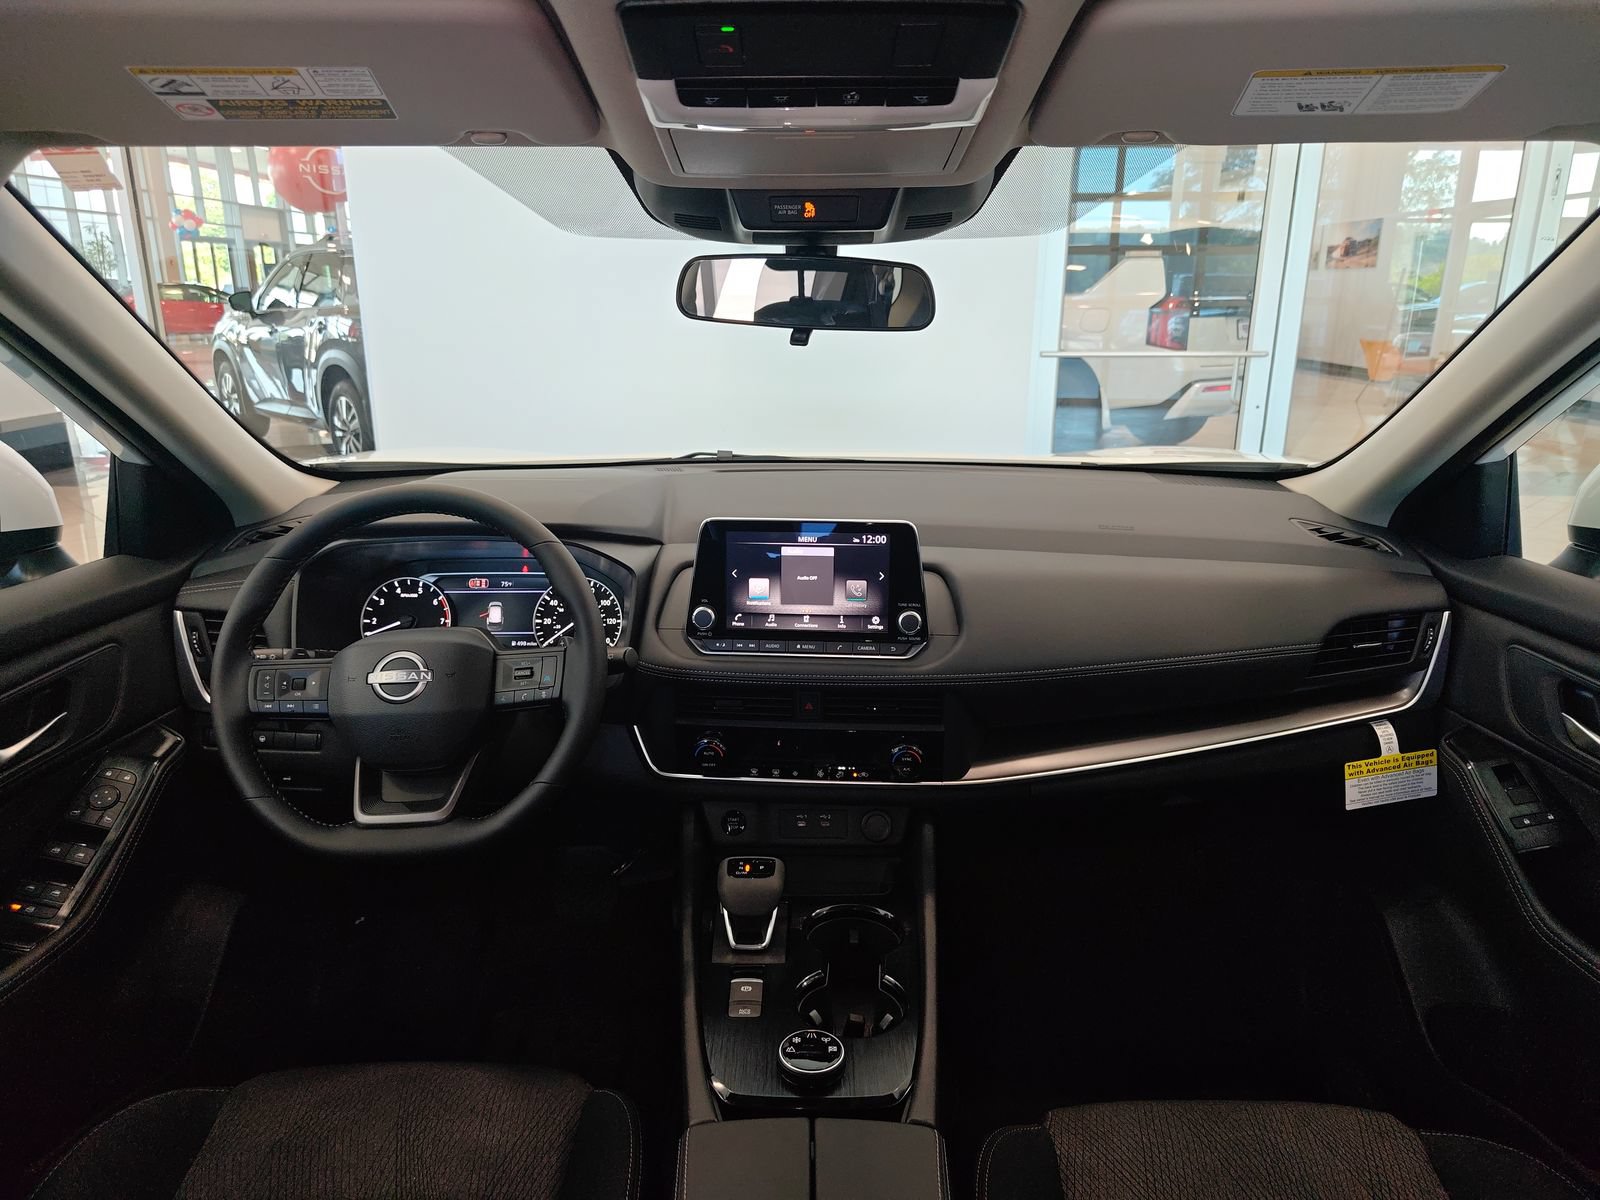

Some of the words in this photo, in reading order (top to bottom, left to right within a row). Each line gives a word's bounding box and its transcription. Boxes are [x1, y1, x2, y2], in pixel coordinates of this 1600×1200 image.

[218, 99, 288, 107] AIRBAG
[296, 99, 384, 107] WARNING
[862, 535, 887, 544] 12:00
[379, 598, 385, 606] 3
[432, 598, 438, 606] 6
[371, 617, 377, 625] 2
[369, 671, 432, 682] NISSAN
[1364, 759, 1391, 767] Vehicle
[1401, 752, 1434, 762] Equipped
[1366, 765, 1401, 774] Advanced
[1381, 771, 1405, 779] Advanced
